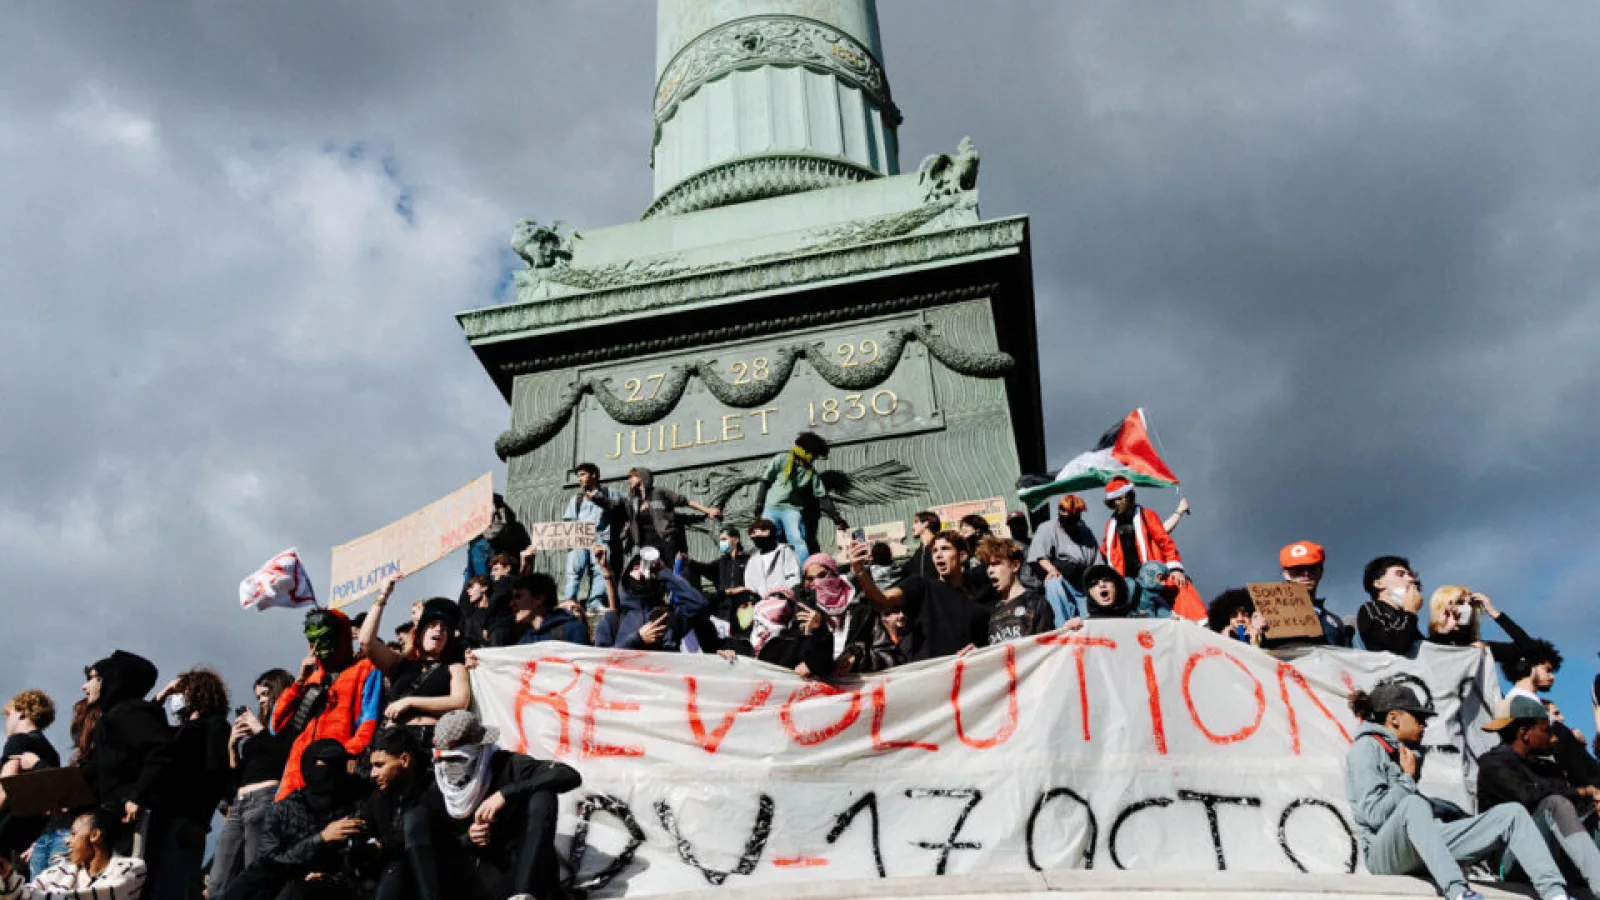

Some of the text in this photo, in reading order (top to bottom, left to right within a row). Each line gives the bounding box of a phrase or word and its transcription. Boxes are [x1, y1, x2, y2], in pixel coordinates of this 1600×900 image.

[624, 339, 878, 402] 27 28 29
[605, 408, 778, 460] JUILLET
[807, 389, 898, 428] 1830
[534, 522, 595, 537] VIVRE
[562, 794, 774, 888] DU
[827, 788, 982, 877] 17
